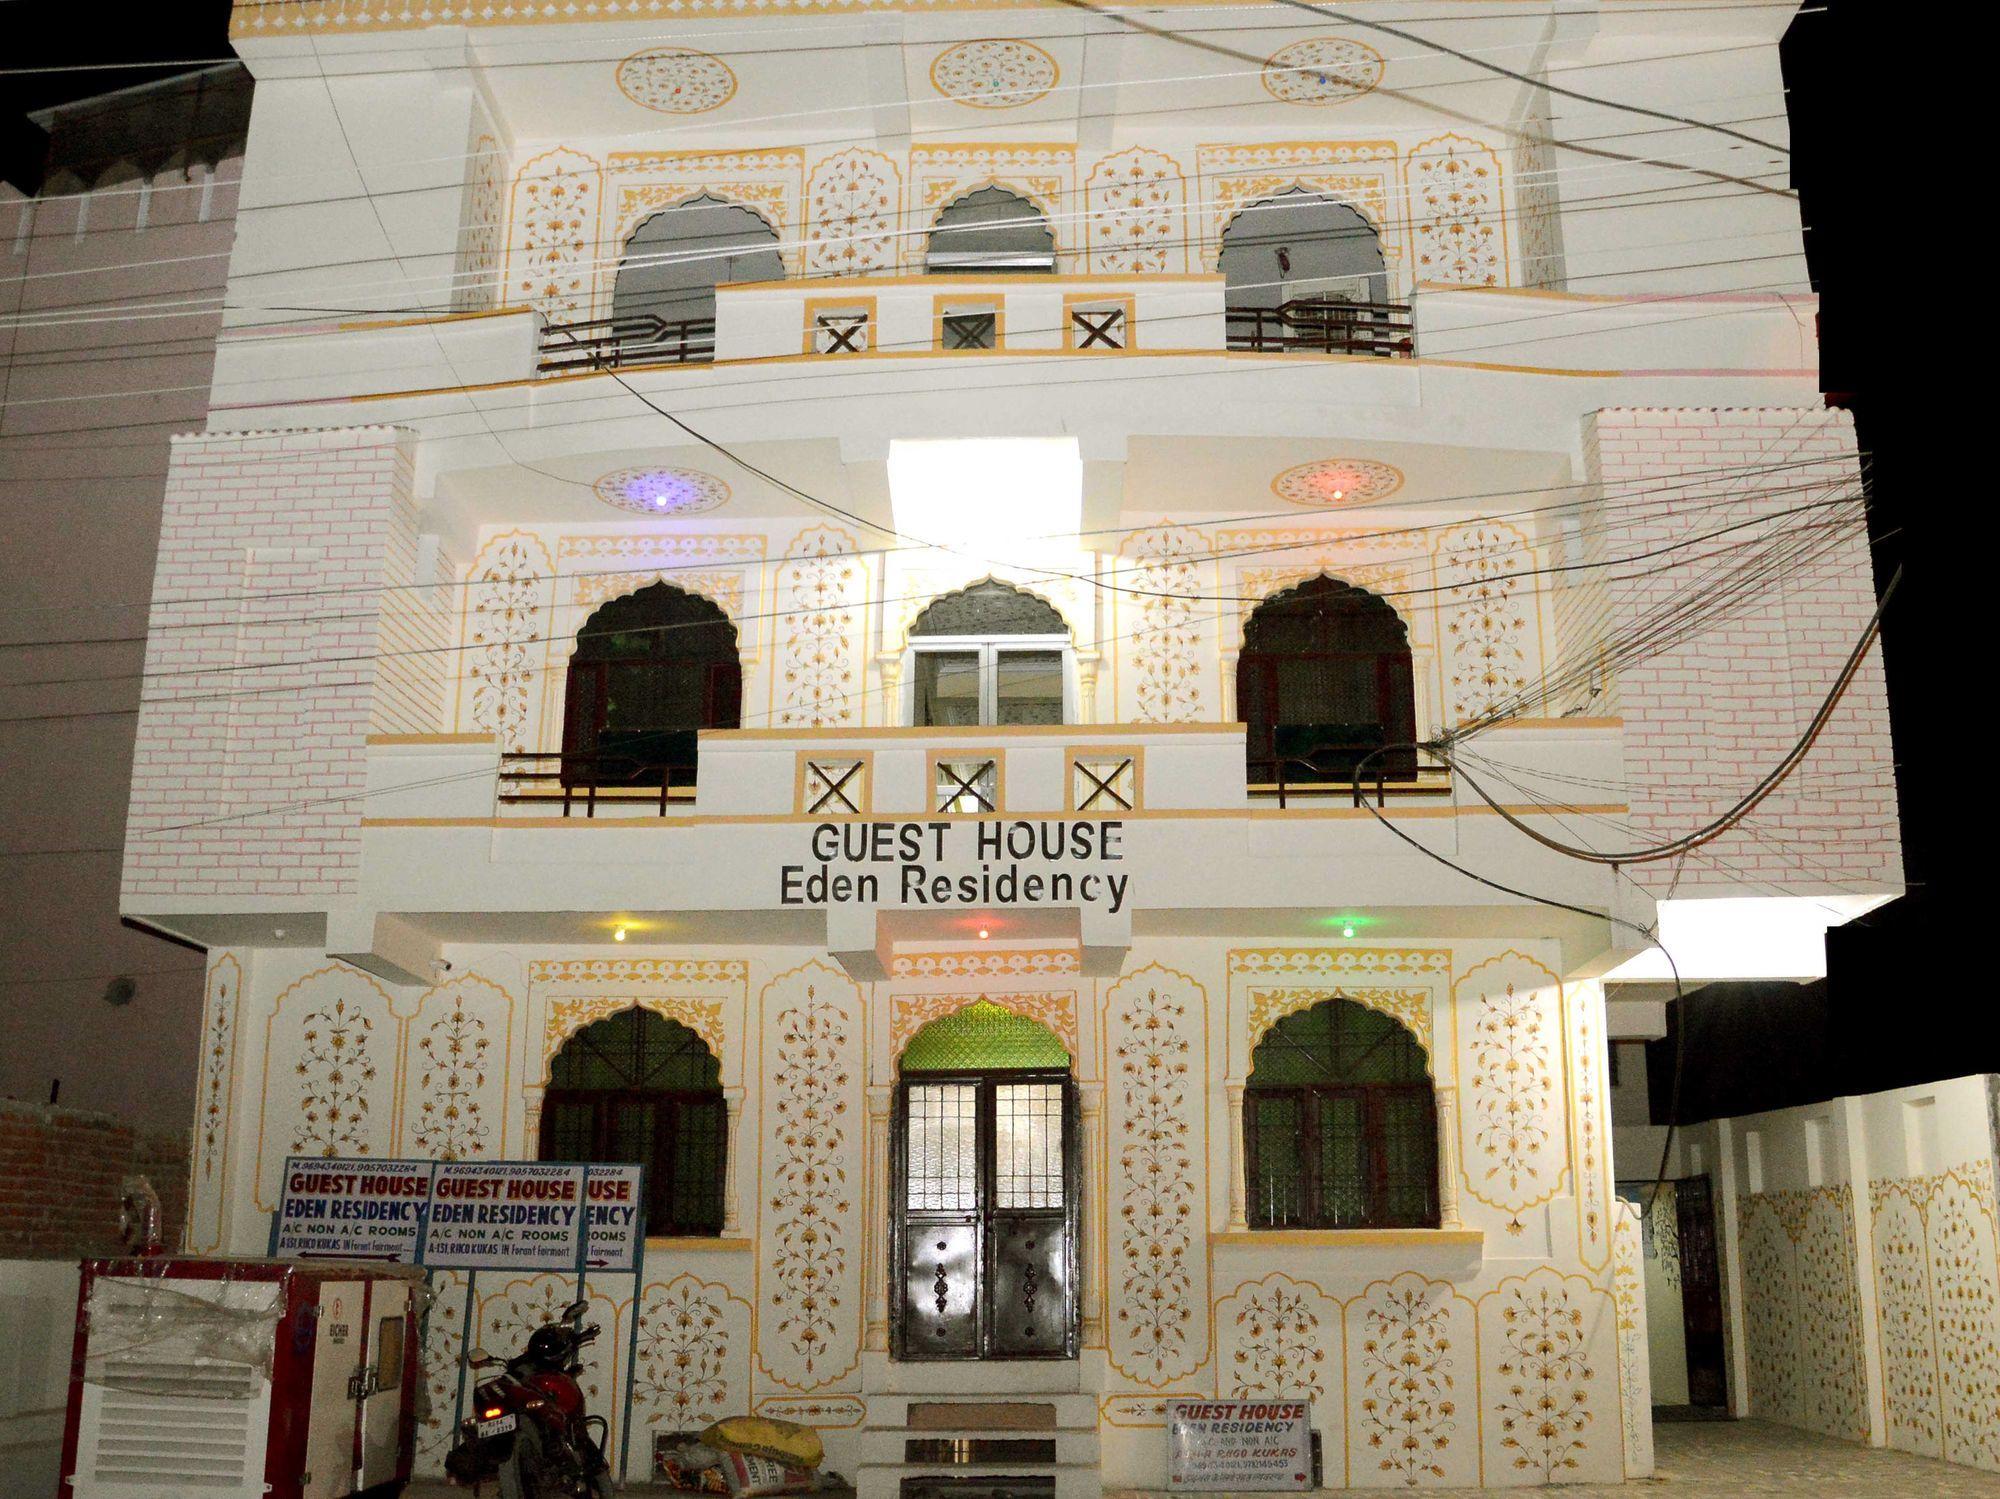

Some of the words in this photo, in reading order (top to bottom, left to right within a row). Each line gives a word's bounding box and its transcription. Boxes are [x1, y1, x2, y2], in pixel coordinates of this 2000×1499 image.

[811, 823, 951, 862] GUEST
[977, 821, 1124, 862] HOUSE
[781, 864, 879, 905] Eden
[900, 864, 1129, 914] Residency
[290, 1173, 358, 1195] GUEST
[360, 1175, 428, 1196] HOUSE
[436, 1178, 505, 1199] GUEST
[506, 1180, 577, 1200] HOUSE
[588, 1180, 630, 1201] USE
[285, 1199, 327, 1219] EDEN
[330, 1200, 430, 1221] RESIDENCY
[432, 1204, 475, 1223] EDEN
[477, 1204, 576, 1225] RESIDENCY
[585, 1205, 636, 1226] ENCY
[283, 1222, 301, 1234] A/C
[307, 1224, 335, 1234] NON
[340, 1221, 363, 1236] A/C
[368, 1226, 417, 1237] ROOMS
[430, 1227, 452, 1241] A/C
[458, 1229, 486, 1239] NON
[491, 1227, 514, 1241] A/C
[521, 1230, 569, 1242] ROOMS
[317, 1238, 341, 1250] KUKAS
[471, 1243, 498, 1255] KUKAS
[1175, 1404, 1237, 1420] GUEST
[1239, 1404, 1305, 1420] HOUSE
[1172, 1422, 1207, 1435] EEN
[1211, 1421, 1294, 1434] RESIDENCY
[1241, 1436, 1260, 1446] NON
[1252, 1448, 1298, 1458] KUKAS
